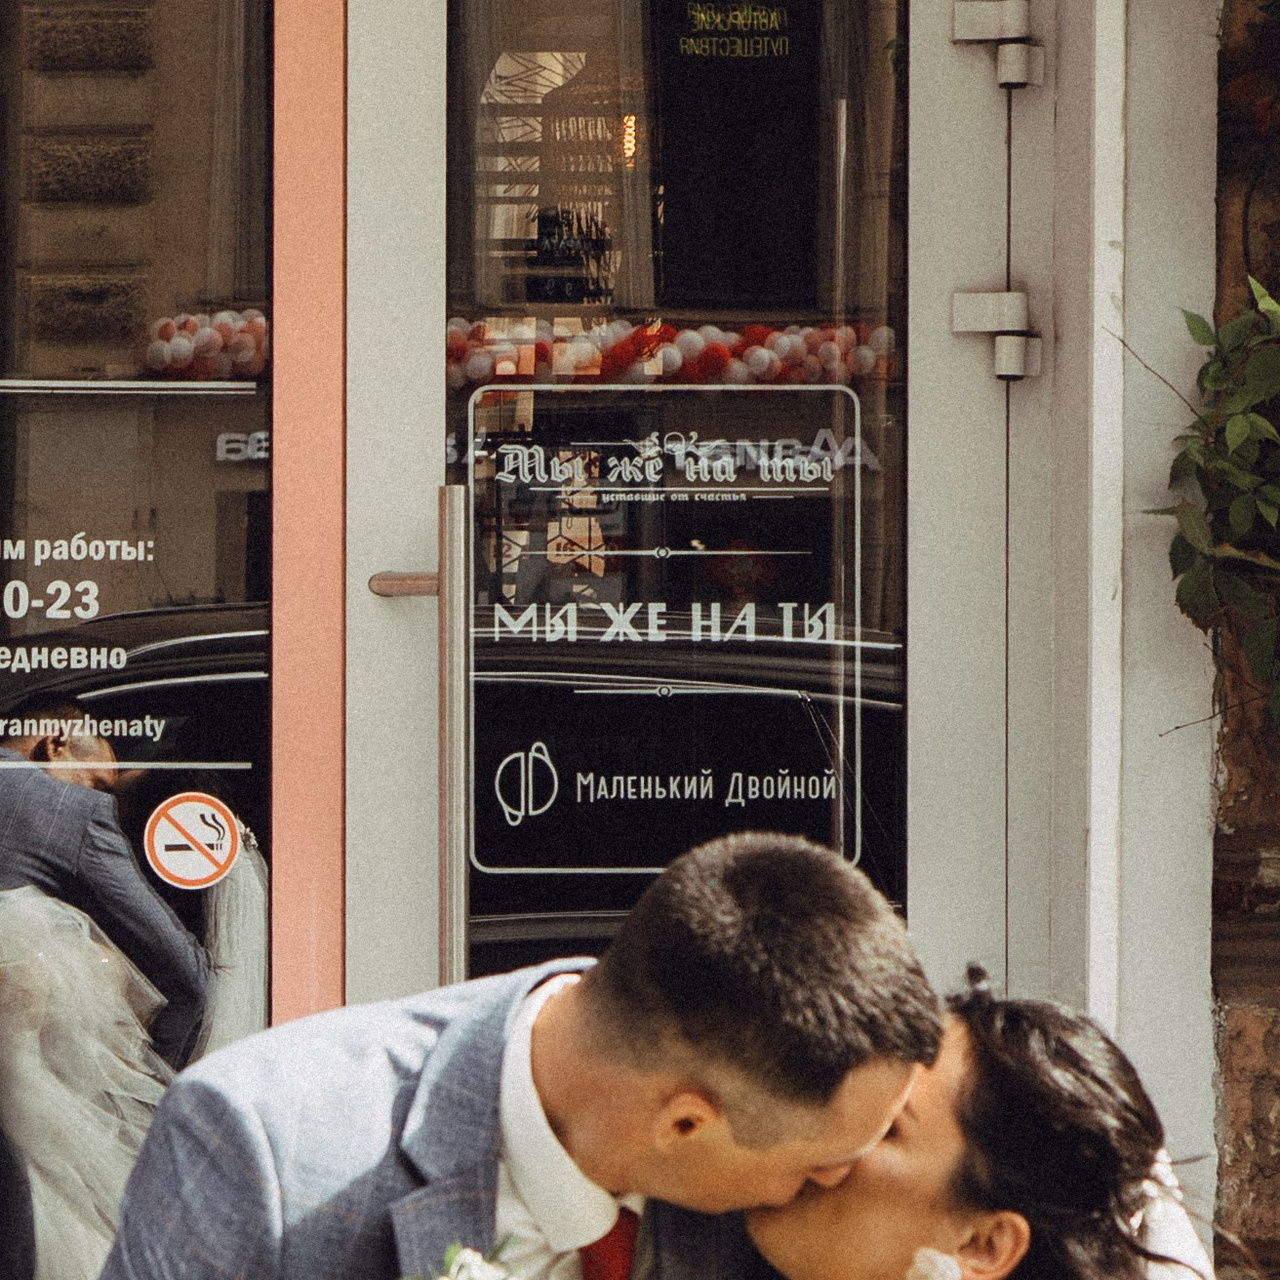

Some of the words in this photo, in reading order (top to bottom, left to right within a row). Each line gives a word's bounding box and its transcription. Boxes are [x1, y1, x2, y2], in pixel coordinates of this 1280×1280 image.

[495, 444, 586, 484] Мы
[607, 454, 663, 484] же
[685, 455, 737, 484] на
[758, 455, 835, 484] ты
[602, 492, 666, 503] уставшие
[670, 493, 689, 502] от
[694, 493, 747, 502] счастья
[34, 532, 155, 564] работы:
[494, 602, 577, 643] МЫ
[600, 602, 668, 643] ЖЕ
[691, 602, 756, 643] НА
[778, 602, 836, 643] ТЫ
